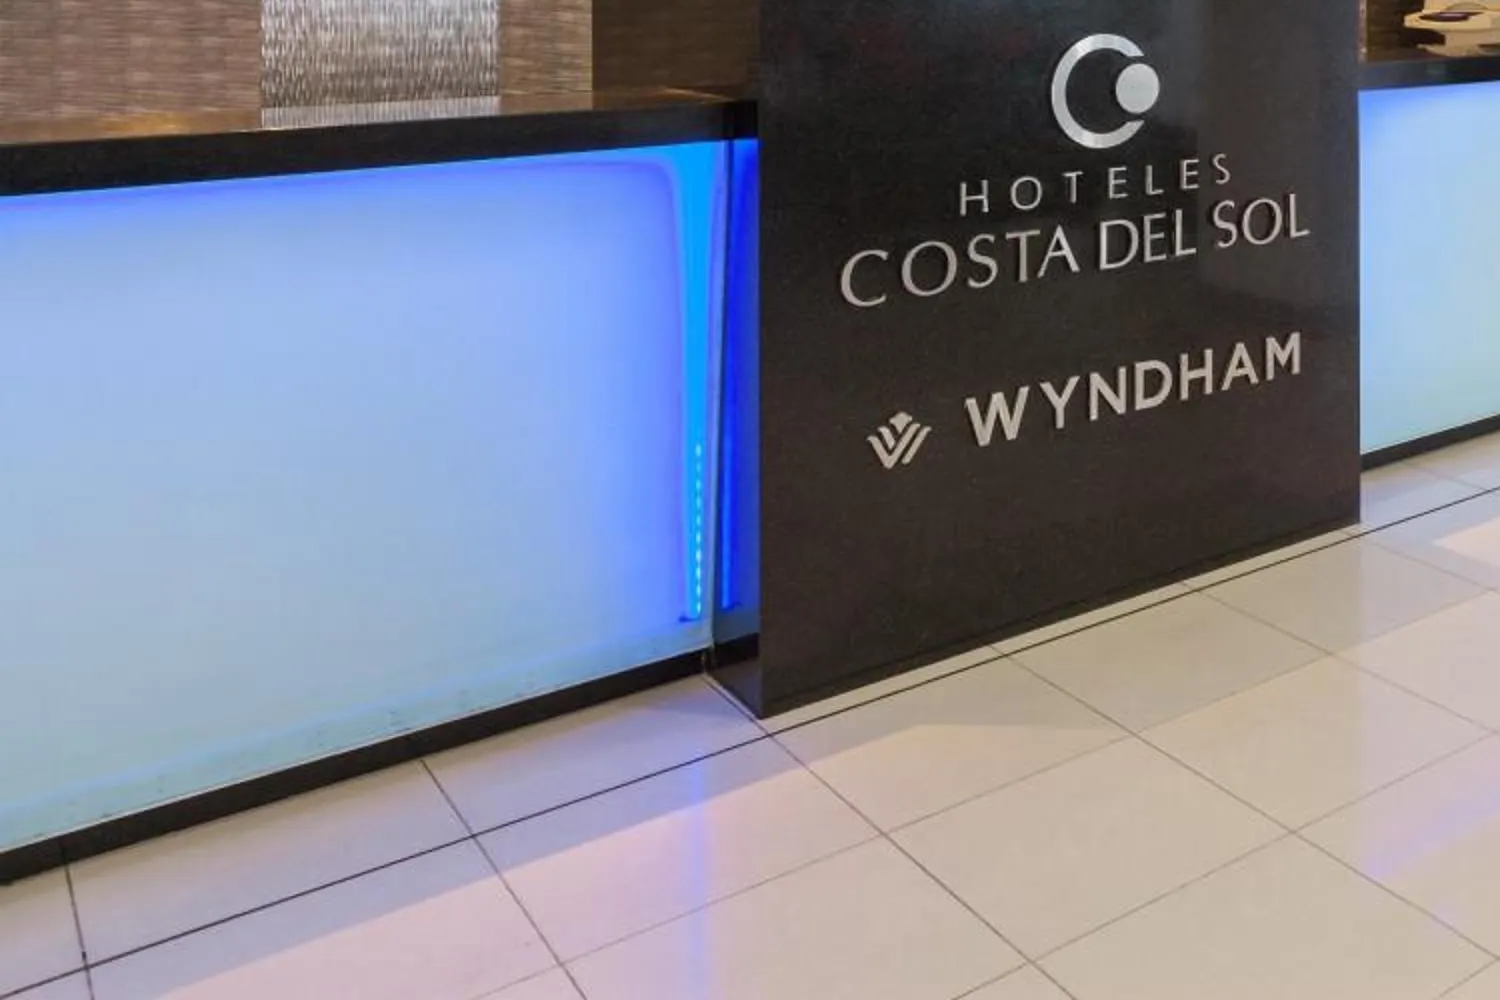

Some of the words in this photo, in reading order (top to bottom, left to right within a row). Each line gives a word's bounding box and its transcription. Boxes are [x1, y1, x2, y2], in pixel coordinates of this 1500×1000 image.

[959, 152, 1232, 217] HOTELES
[839, 223, 1081, 308] COSTA
[1098, 208, 1197, 271] DEL
[1211, 192, 1312, 250] SOL
[964, 331, 1302, 448] WYNDHAM
